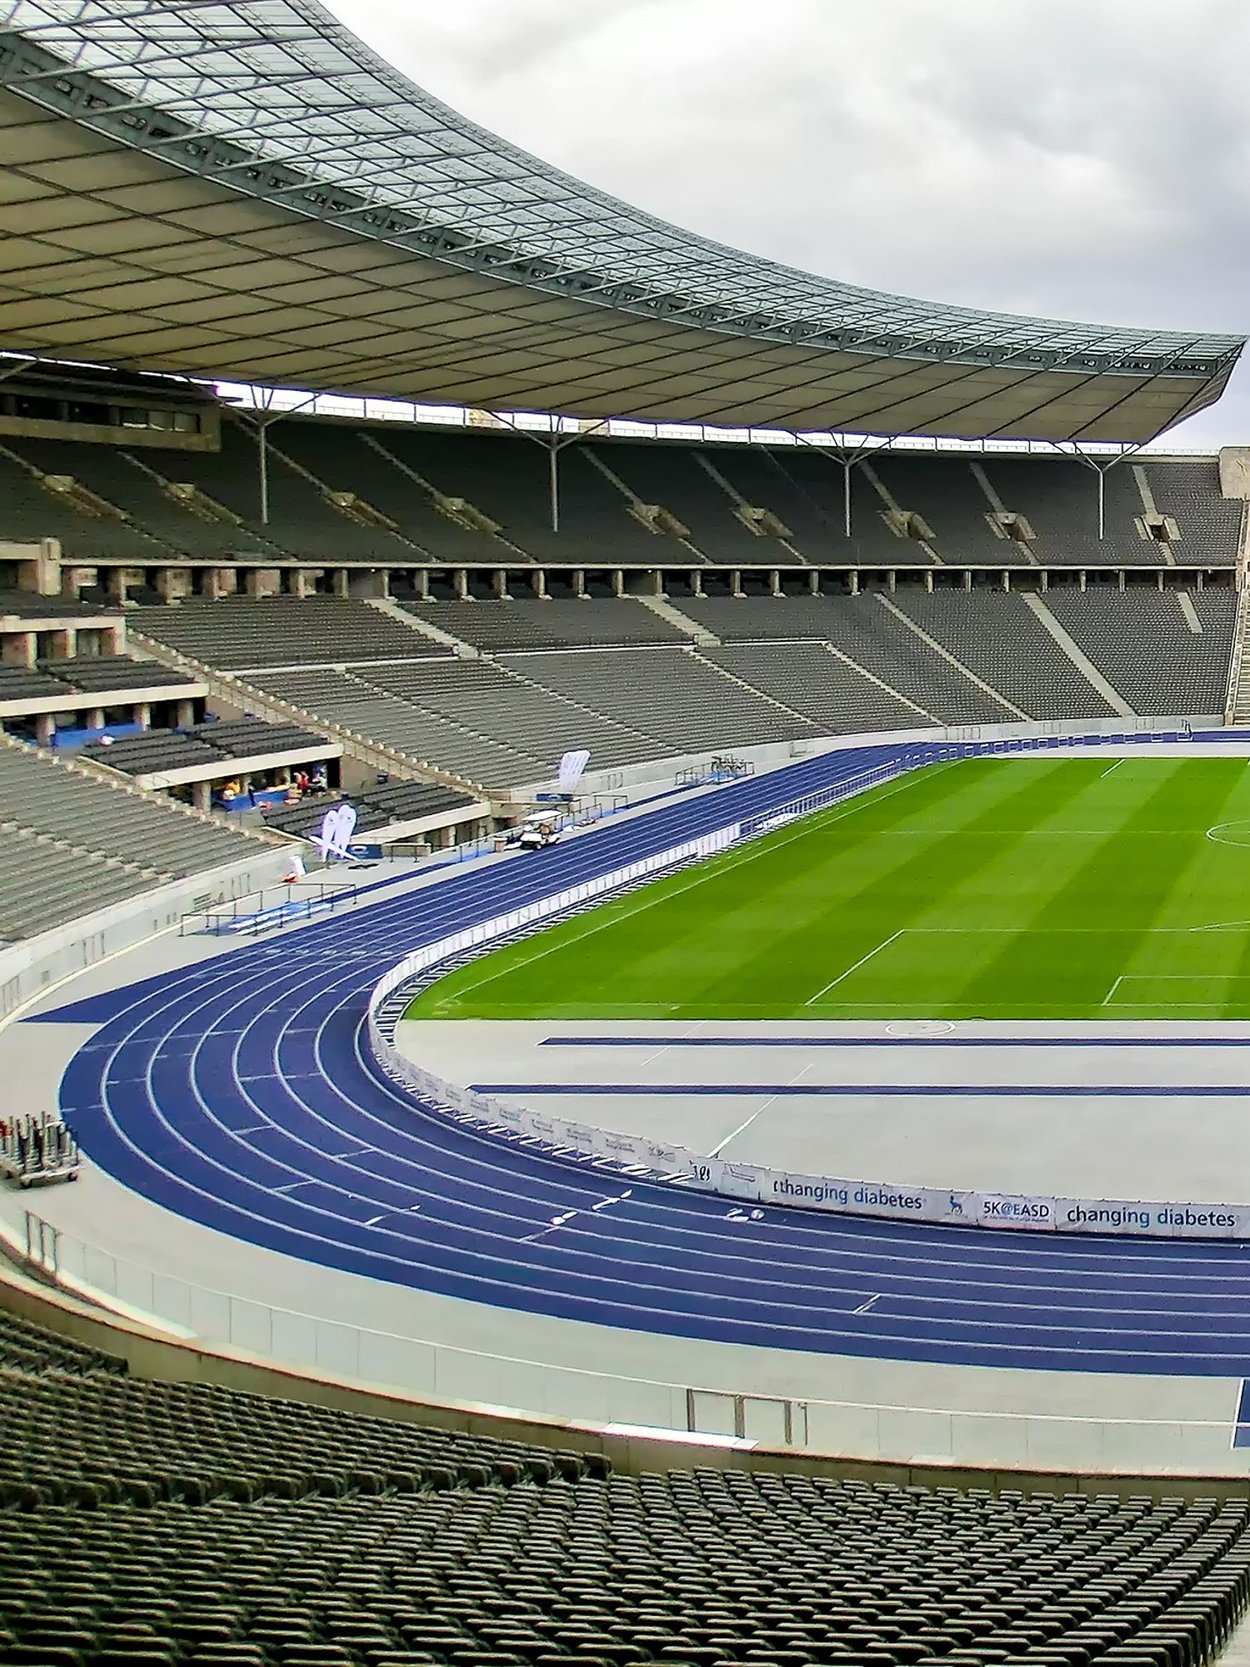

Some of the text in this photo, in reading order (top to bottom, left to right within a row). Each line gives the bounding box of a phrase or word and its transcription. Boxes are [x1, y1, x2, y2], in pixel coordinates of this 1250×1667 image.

[853, 1187, 923, 1210] diabetes
[983, 1201, 1050, 1218] 5K@EASD
[1066, 1205, 1236, 1228] changing diabetes
